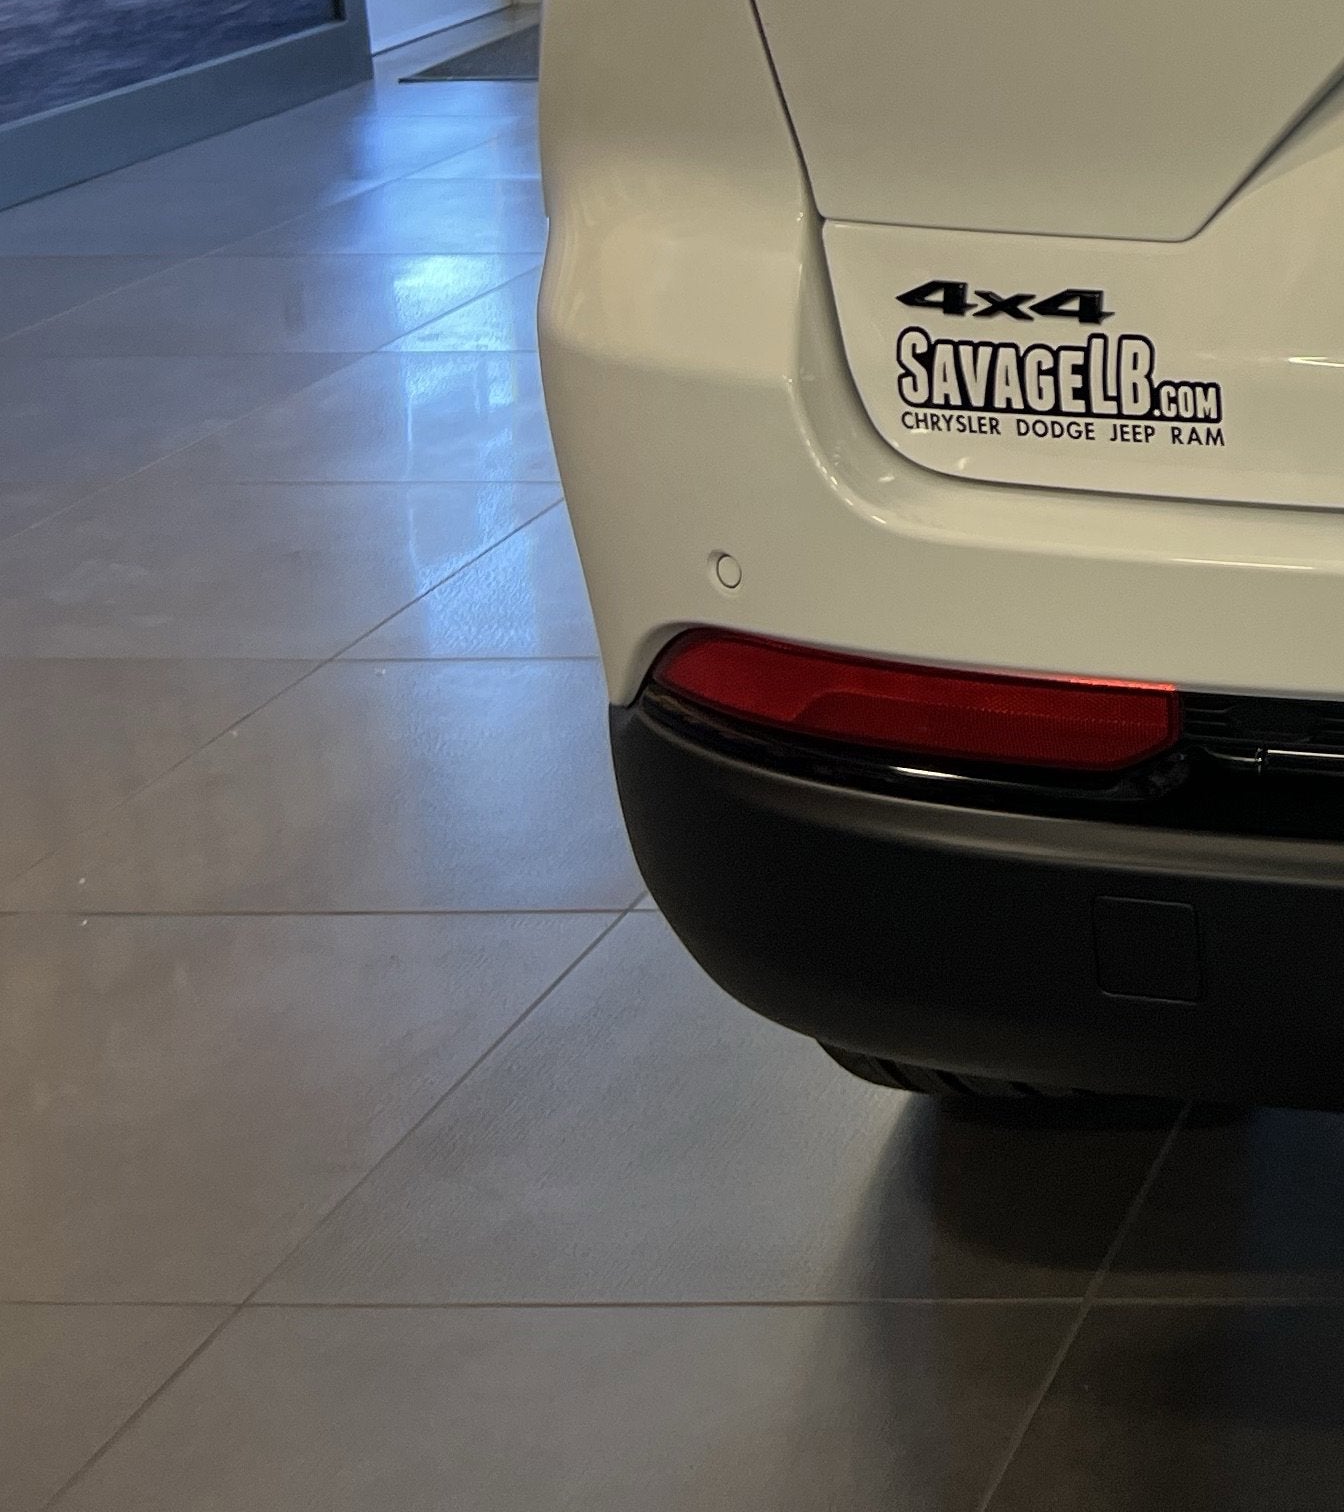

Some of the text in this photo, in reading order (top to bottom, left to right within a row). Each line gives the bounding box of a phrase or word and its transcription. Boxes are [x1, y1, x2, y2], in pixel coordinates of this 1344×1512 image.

[896, 280, 1115, 325] 4x4
[901, 411, 1226, 447] CHRYSLER DODGE JEEP RAM
